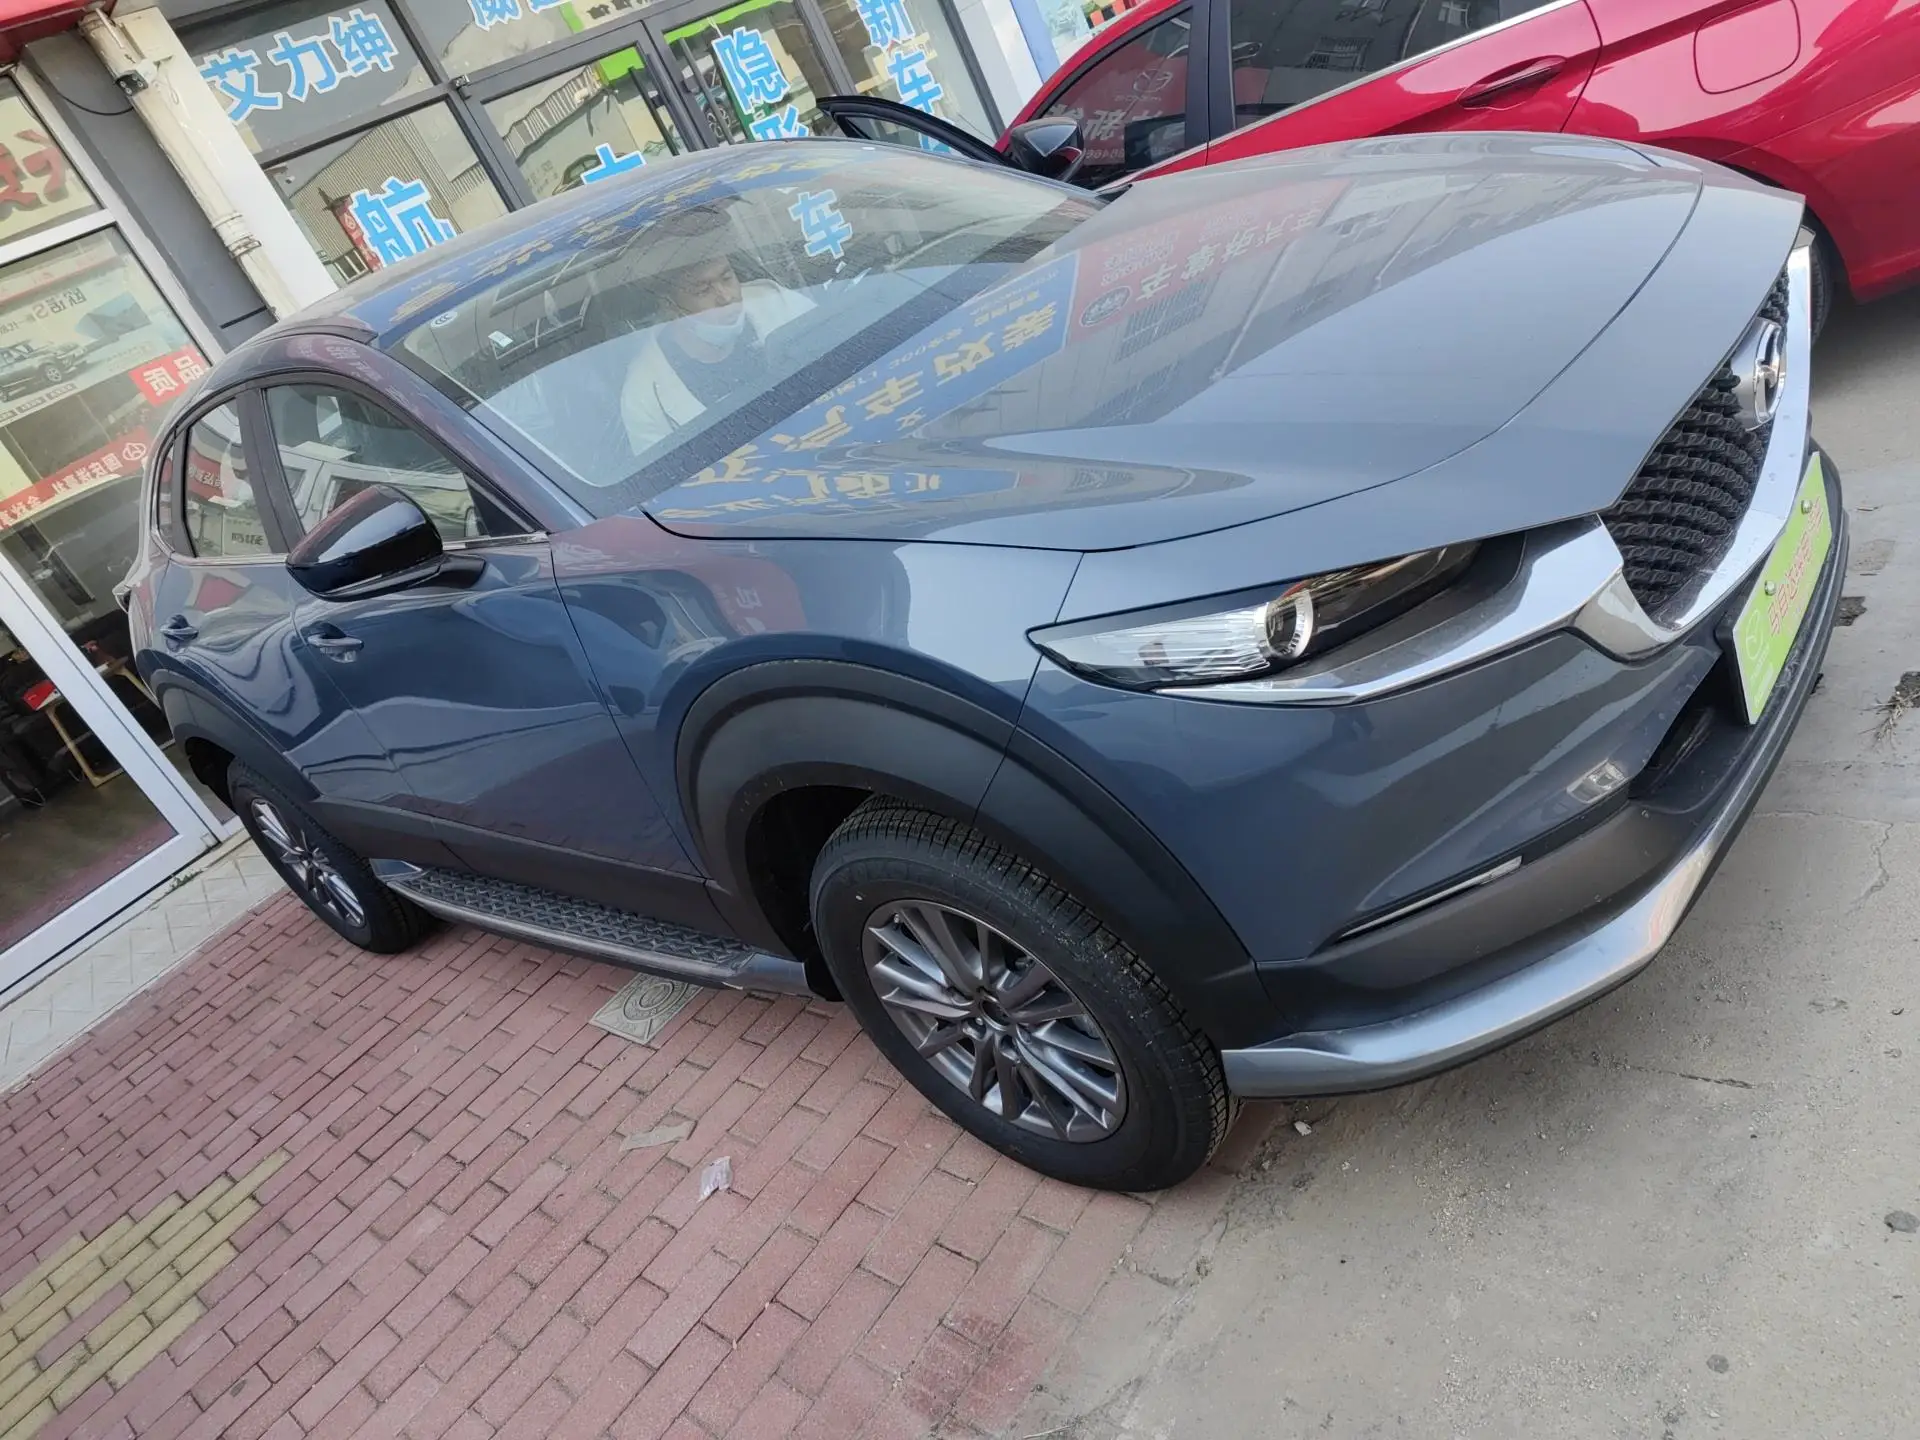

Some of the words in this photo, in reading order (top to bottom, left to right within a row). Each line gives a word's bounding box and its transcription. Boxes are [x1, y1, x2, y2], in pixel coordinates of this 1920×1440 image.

[200, 8, 399, 123] 艾力绅
[349, 176, 458, 268] 航
